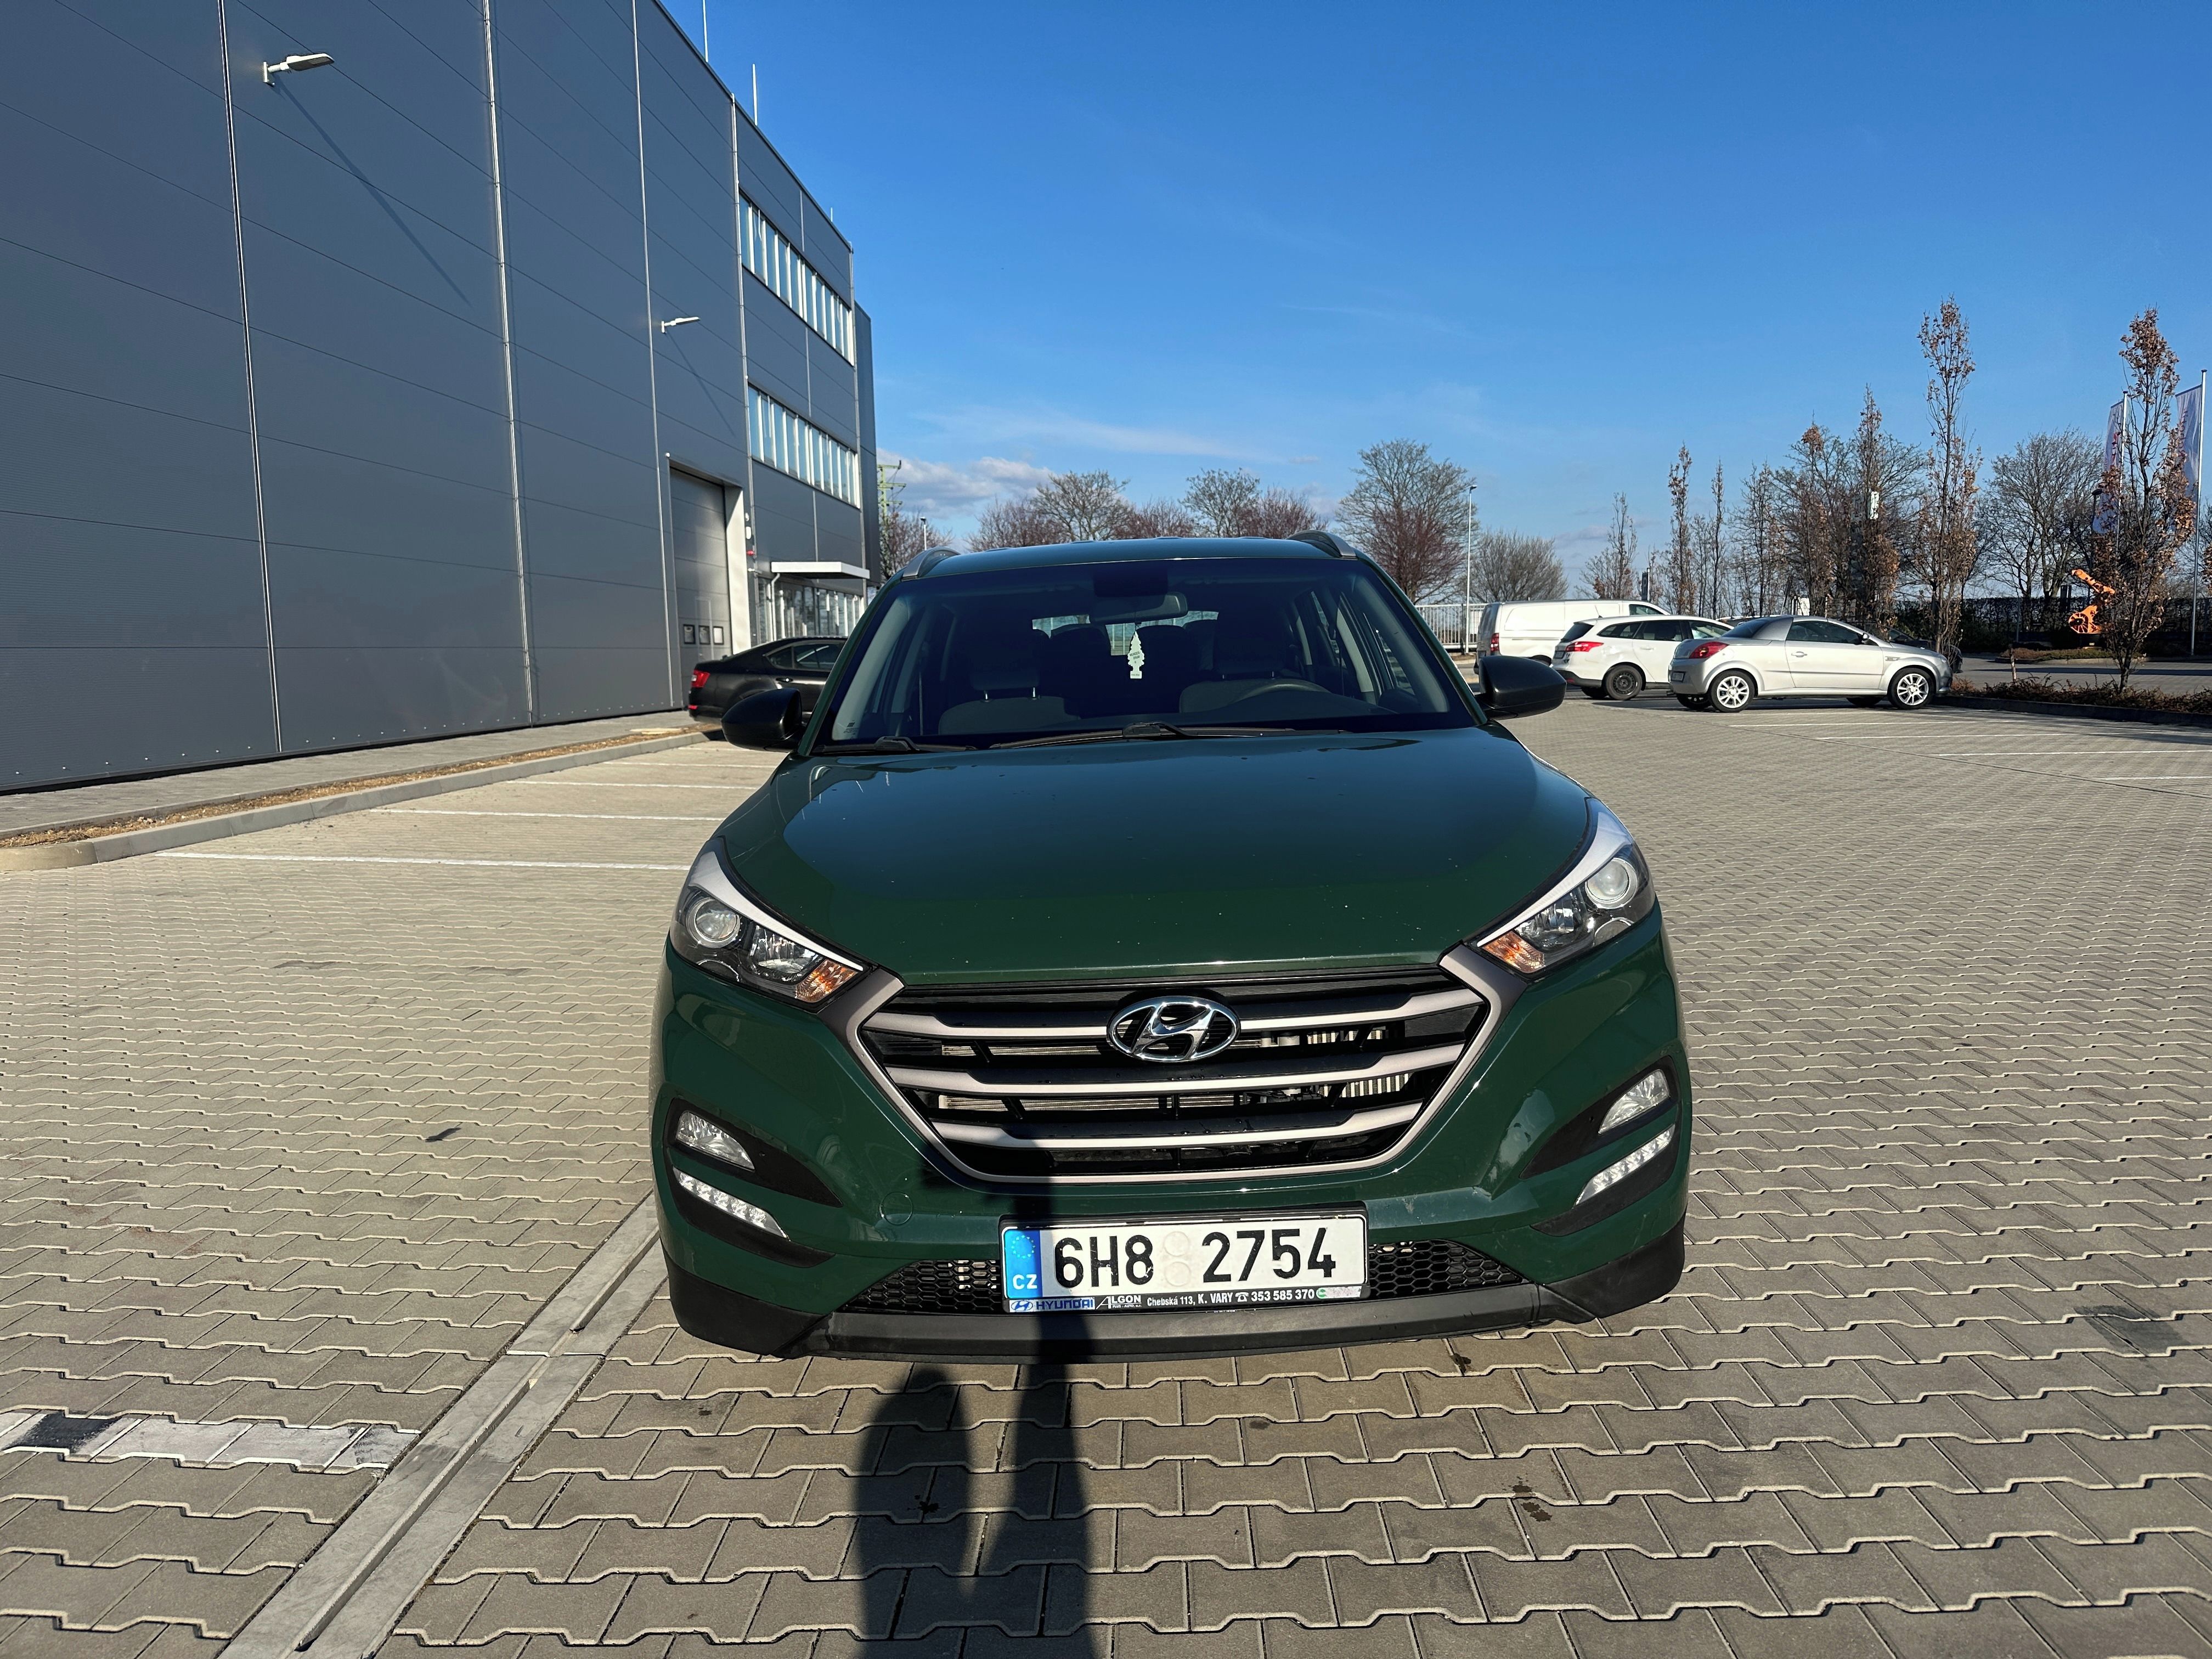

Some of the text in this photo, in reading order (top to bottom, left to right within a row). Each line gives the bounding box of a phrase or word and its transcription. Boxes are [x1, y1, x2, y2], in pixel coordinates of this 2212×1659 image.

[1054, 1227, 1336, 1288] 6H8 2754
[1012, 1274, 1038, 1290] CZ
[1036, 1298, 1094, 1311] HYUNDAI
[1096, 1295, 1142, 1310] ALGON
[1147, 1295, 1178, 1306] Chebská
[1180, 1295, 1195, 1306] 113,
[1198, 1293, 1208, 1304] K.
[1210, 1292, 1233, 1304] VARY
[1251, 1290, 1271, 1302] 353
[1273, 1289, 1293, 1301] 585
[1295, 1289, 1315, 1300] 370
